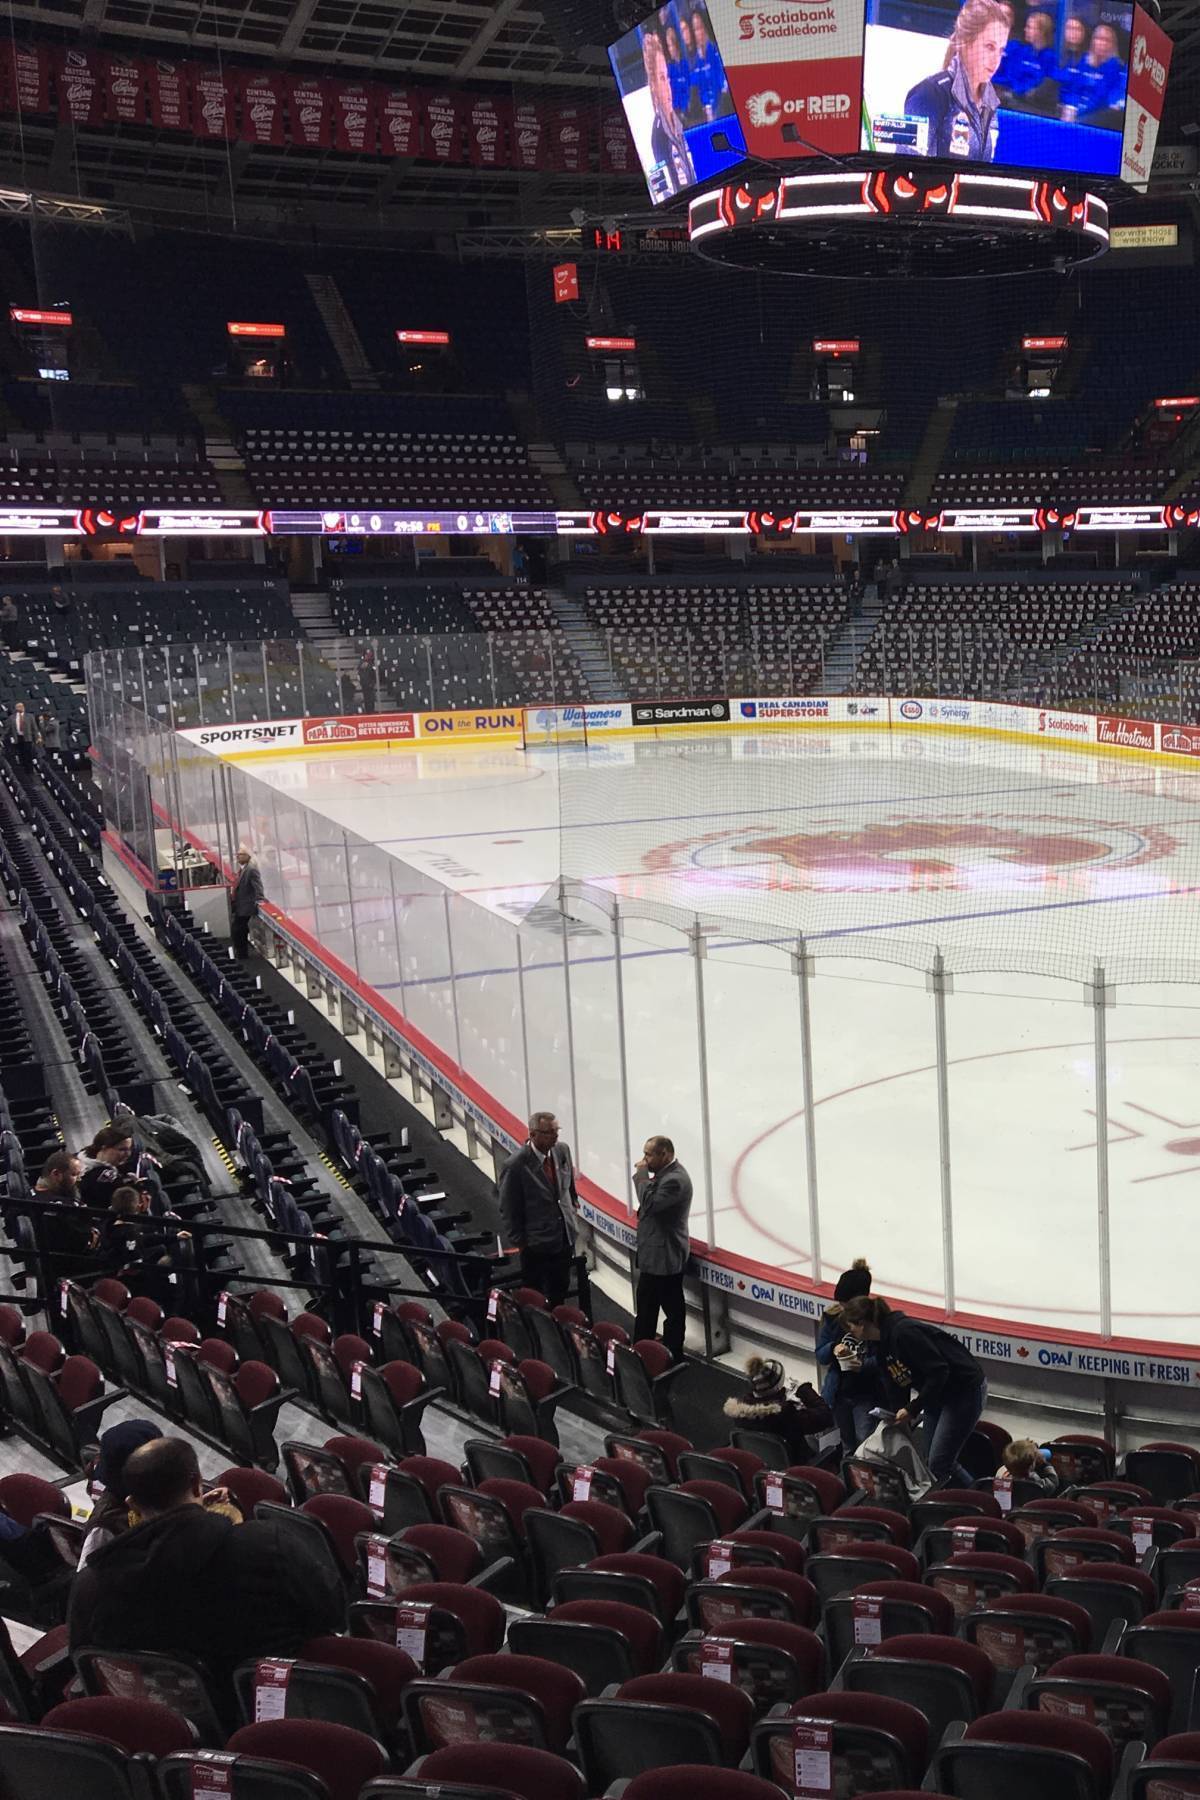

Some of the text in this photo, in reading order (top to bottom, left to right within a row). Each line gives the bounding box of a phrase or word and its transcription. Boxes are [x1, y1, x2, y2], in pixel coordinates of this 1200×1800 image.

[757, 7, 835, 25] Scotiabank
[759, 23, 838, 39] Saddledome
[783, 99, 804, 113] OF
[807, 94, 851, 114] RED
[1122, 235, 1165, 245] WHO KNOW
[1127, 229, 1147, 237] WITH
[1148, 228, 1173, 237] THOSE
[370, 514, 381, 531] 0
[457, 514, 468, 531] 0
[331, 579, 344, 587] 115
[563, 708, 622, 722] Wawanesa
[655, 708, 709, 719] Sandman
[758, 708, 829, 717] SUPERSTORE
[941, 707, 970, 719] Synergy
[359, 727, 387, 735] BETTER
[425, 714, 514, 732] ON the RUN
[1049, 717, 1088, 733] Scotiabank
[200, 725, 297, 744] SPORTSNET
[1098, 720, 1116, 741] Tim
[1116, 722, 1153, 748] Hortons
[596, 1212, 615, 1236] KEEPING
[702, 1266, 734, 1290] IT FRESH
[778, 1291, 815, 1315] KEEPING
[817, 1303, 826, 1317] IT
[976, 1338, 1011, 1358] FRESH
[1079, 1354, 1130, 1376] KEEPING
[1133, 1360, 1146, 1377] IT
[1150, 1361, 1190, 1382] FRESH
